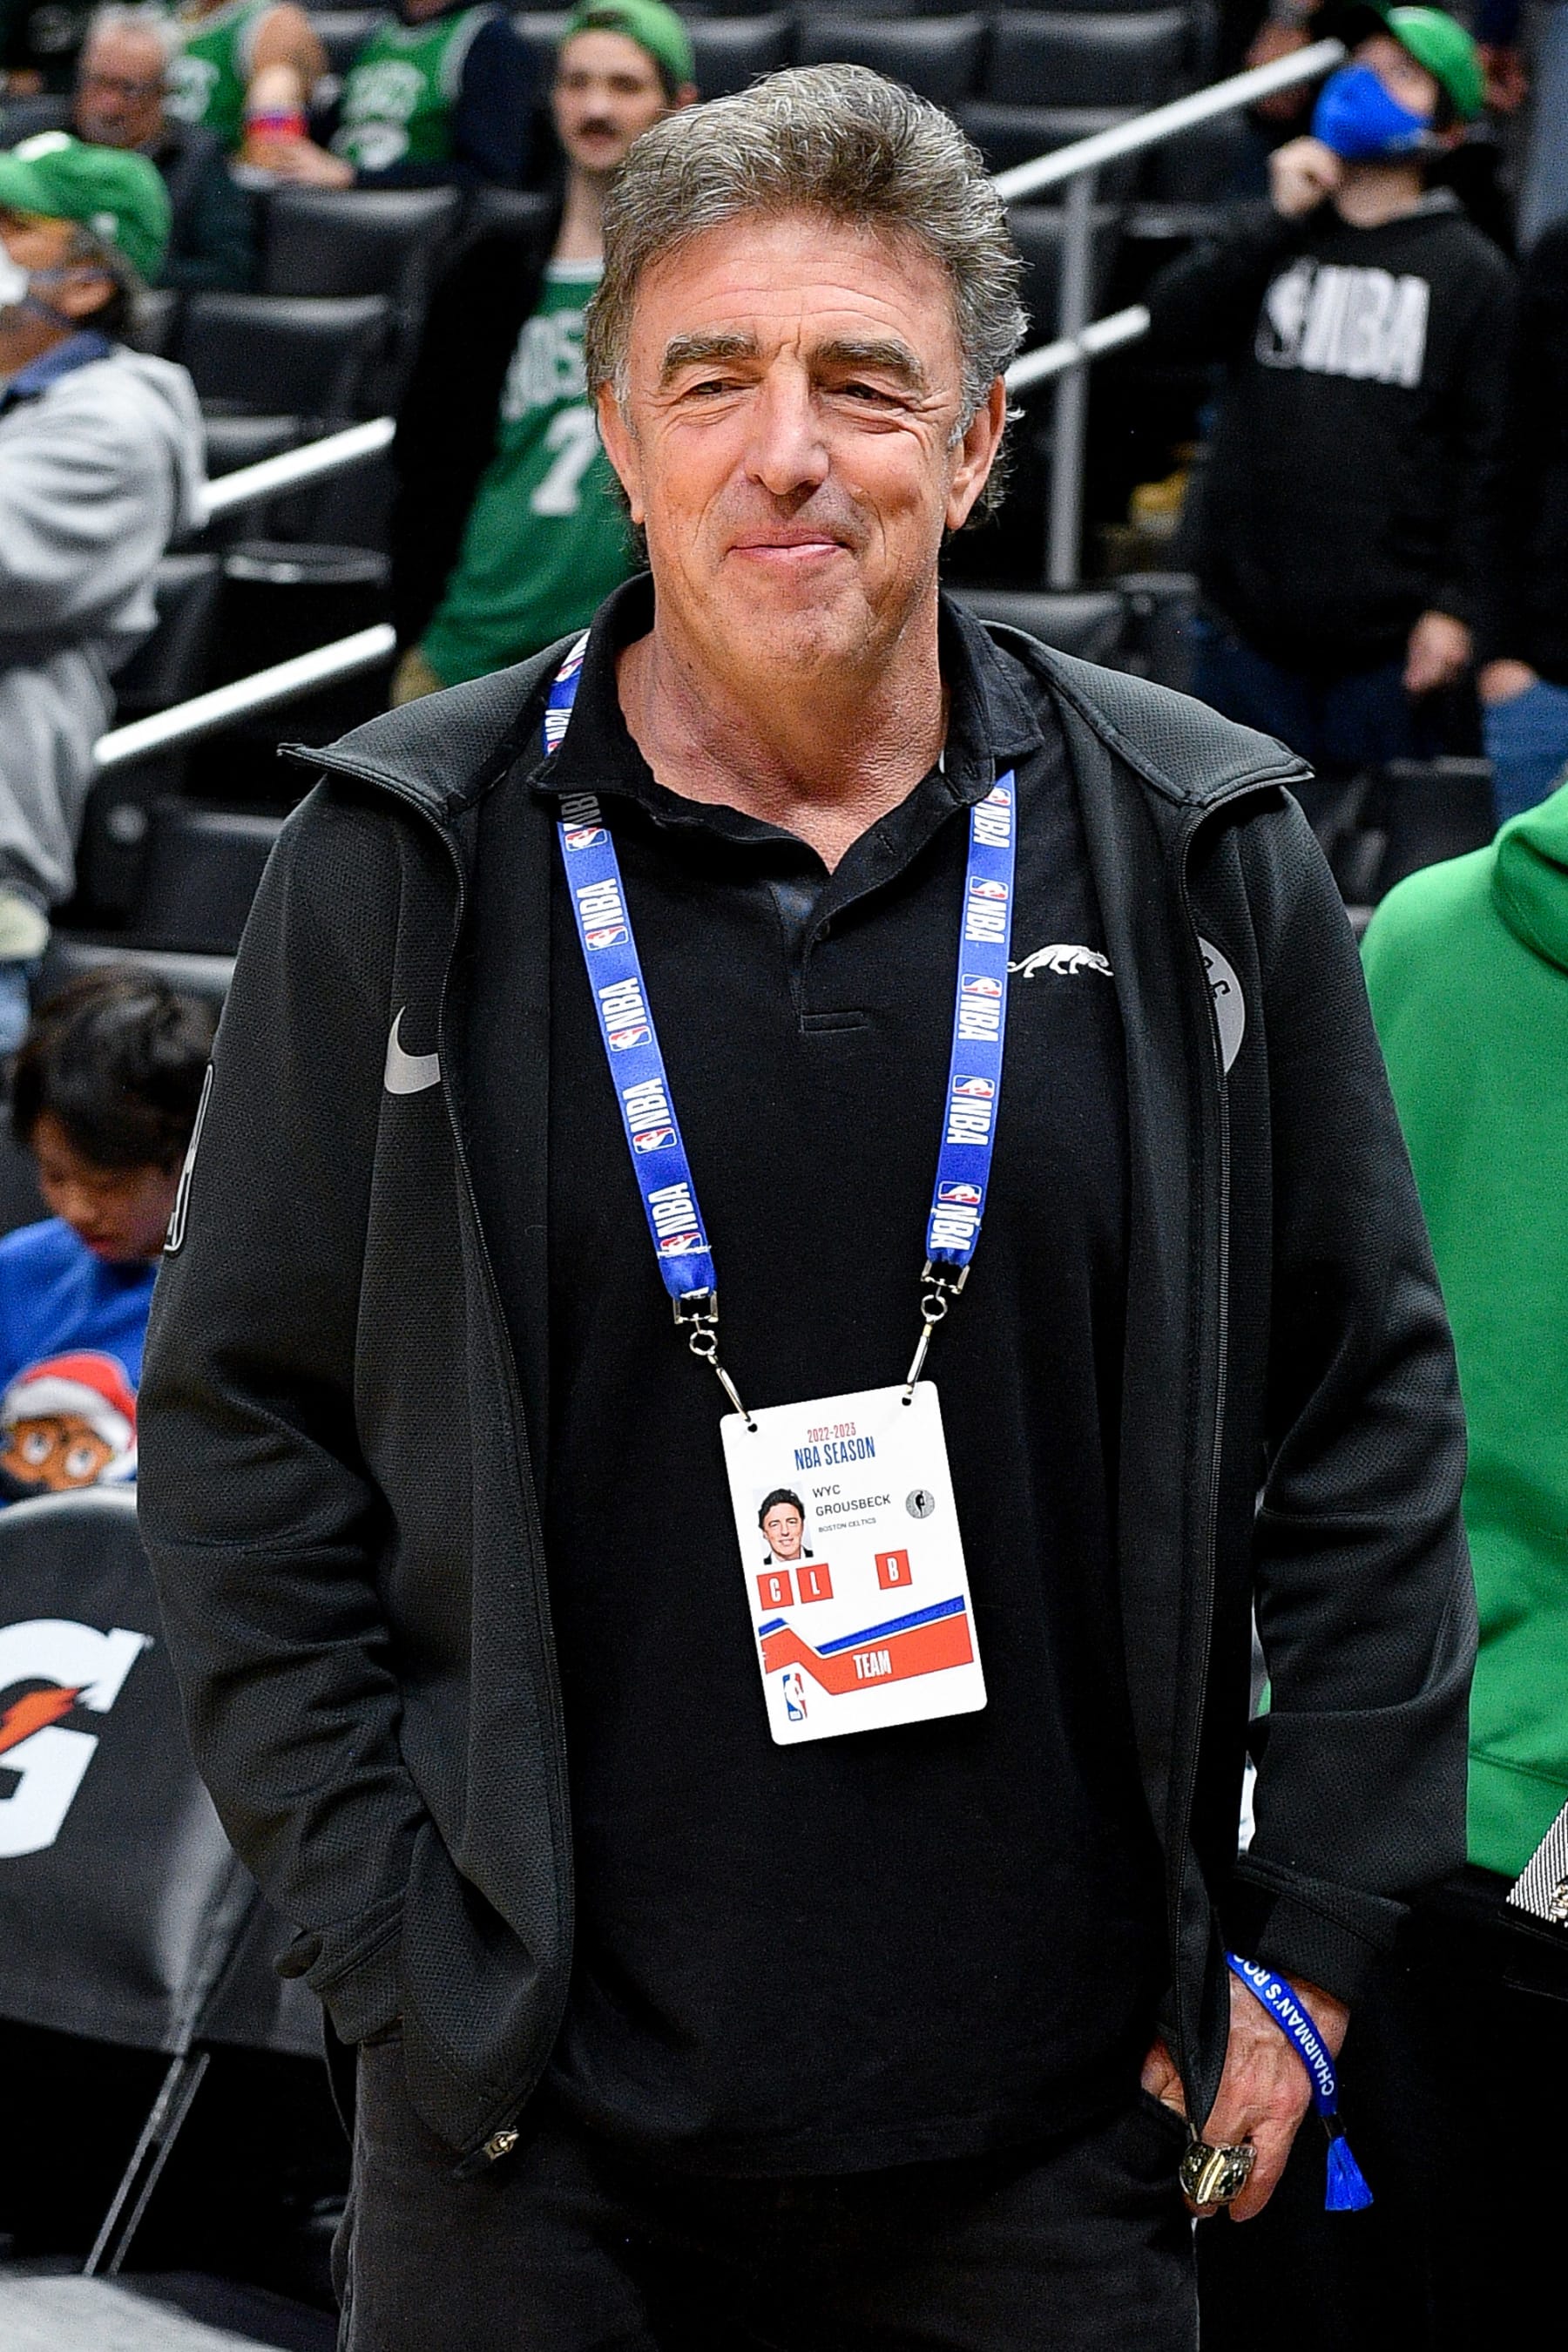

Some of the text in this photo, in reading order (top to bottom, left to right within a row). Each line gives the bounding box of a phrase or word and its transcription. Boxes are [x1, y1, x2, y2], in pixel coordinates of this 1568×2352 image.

[544, 406, 601, 516] 7
[973, 801, 1011, 848] NBA
[577, 878, 625, 931] NBA
[964, 896, 1007, 943] NBA
[598, 977, 647, 1032] NBA
[957, 994, 1001, 1043] NBA
[622, 1077, 672, 1132] NBA
[946, 1096, 993, 1146] NBA
[647, 1181, 699, 1238] NBA
[929, 1202, 979, 1251] NBA
[794, 1436, 875, 1471] NBA SEASON
[808, 1422, 856, 1443] 2022-2023
[812, 1484, 841, 1498] WYC
[815, 1494, 891, 1517] GROUSBECK
[818, 1517, 876, 1533] BOSTON CELTICS
[809, 1570, 821, 1596] L
[886, 1556, 900, 1583] B
[852, 1649, 892, 1680] TEAM
[1265, 1984, 1335, 2096] CHAIRMAN'S
